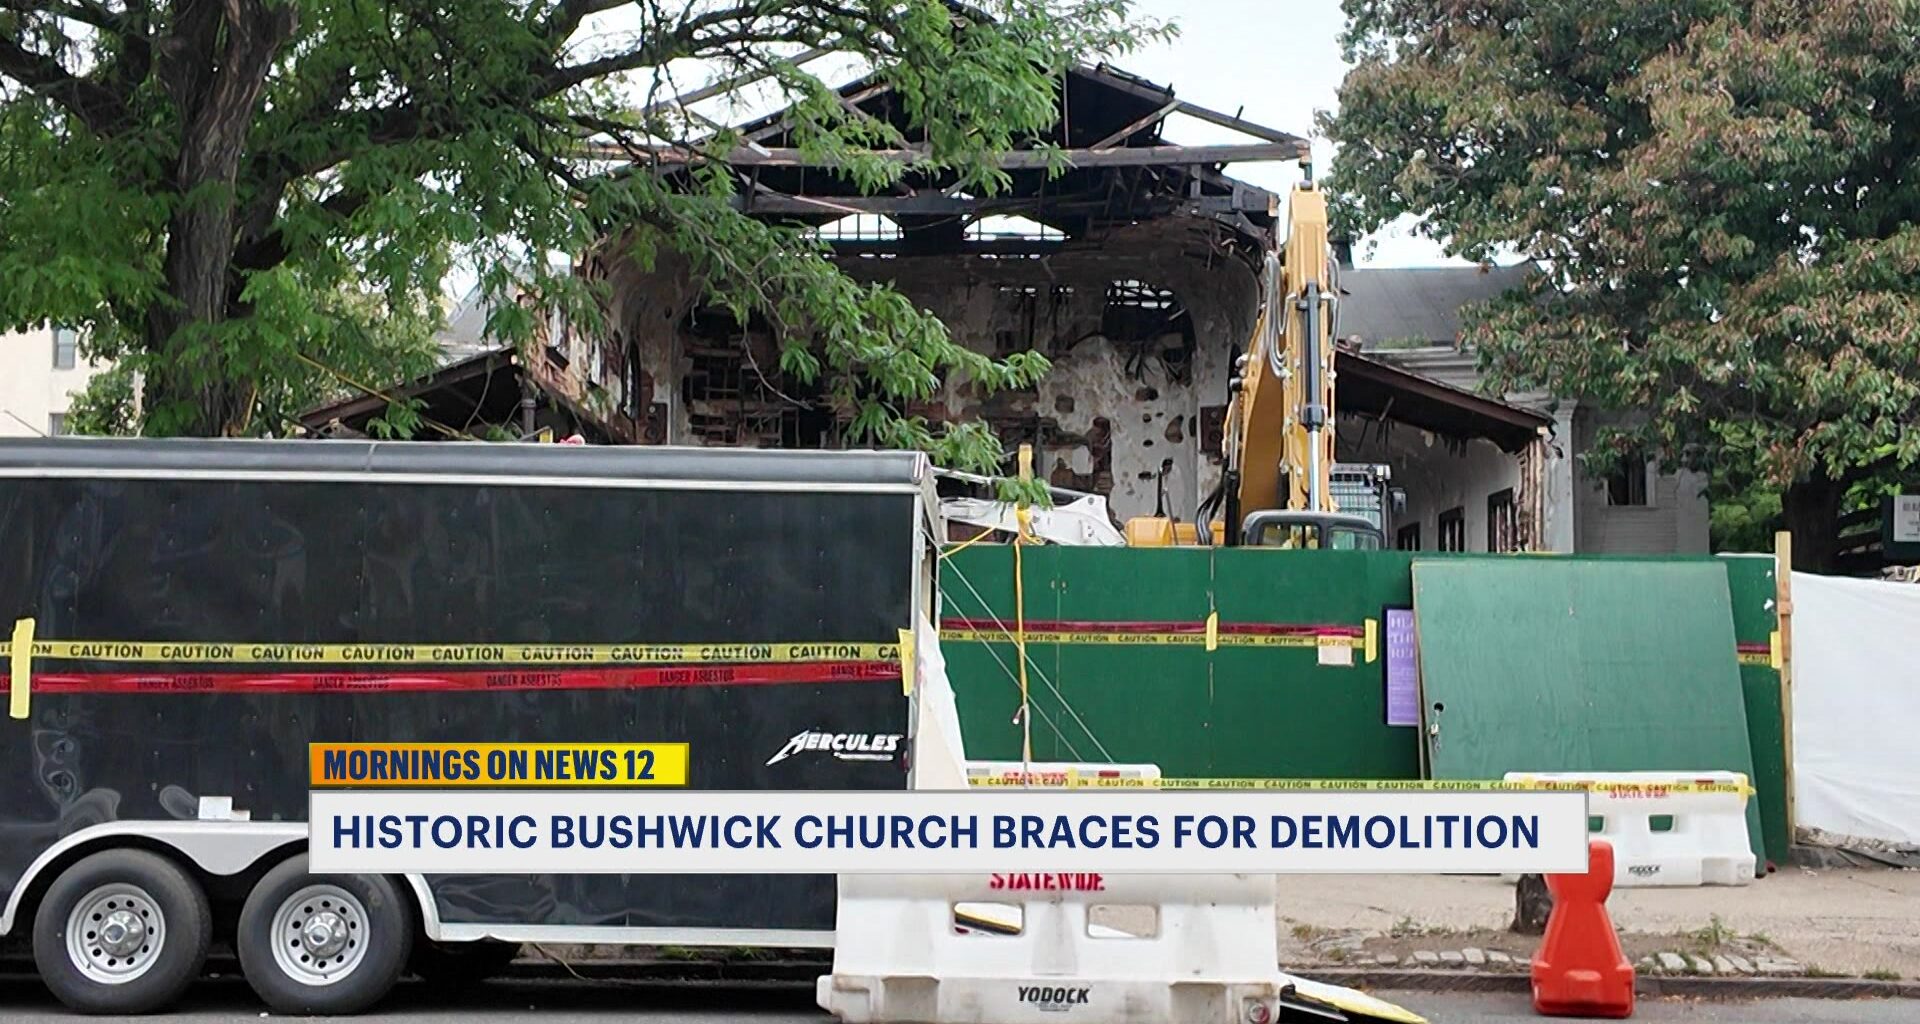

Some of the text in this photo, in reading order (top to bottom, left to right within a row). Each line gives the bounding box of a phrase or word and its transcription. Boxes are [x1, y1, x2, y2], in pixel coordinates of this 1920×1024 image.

[1069, 633, 1109, 642] CAUTION
[1118, 634, 1158, 642] CAUTION
[1167, 634, 1206, 643] CAUTION
[1264, 636, 1304, 645] CAUTION
[70, 644, 861, 660] CAUTION CAUTION CAUTION CAUTION CAUTION CAUTION CAUTION CAUTION CAUTION
[486, 674, 519, 687] DANGER
[520, 673, 562, 687] ASBESTOS
[659, 670, 691, 684] DANGER
[693, 668, 735, 683] ASBESTOS
[765, 730, 904, 766] HERCULES
[1097, 779, 1143, 787] CAUTION
[1153, 779, 1199, 787] CAUTION
[1208, 780, 1255, 788] CAUTION
[1264, 781, 1311, 789] CAUTION
[1320, 781, 1367, 789] CAUTION
[1545, 782, 1589, 790] CAUTION
[1697, 784, 1739, 792] CAUTION
[990, 873, 1105, 891] STATEWIDE
[1018, 986, 1090, 1004] YODOCK
